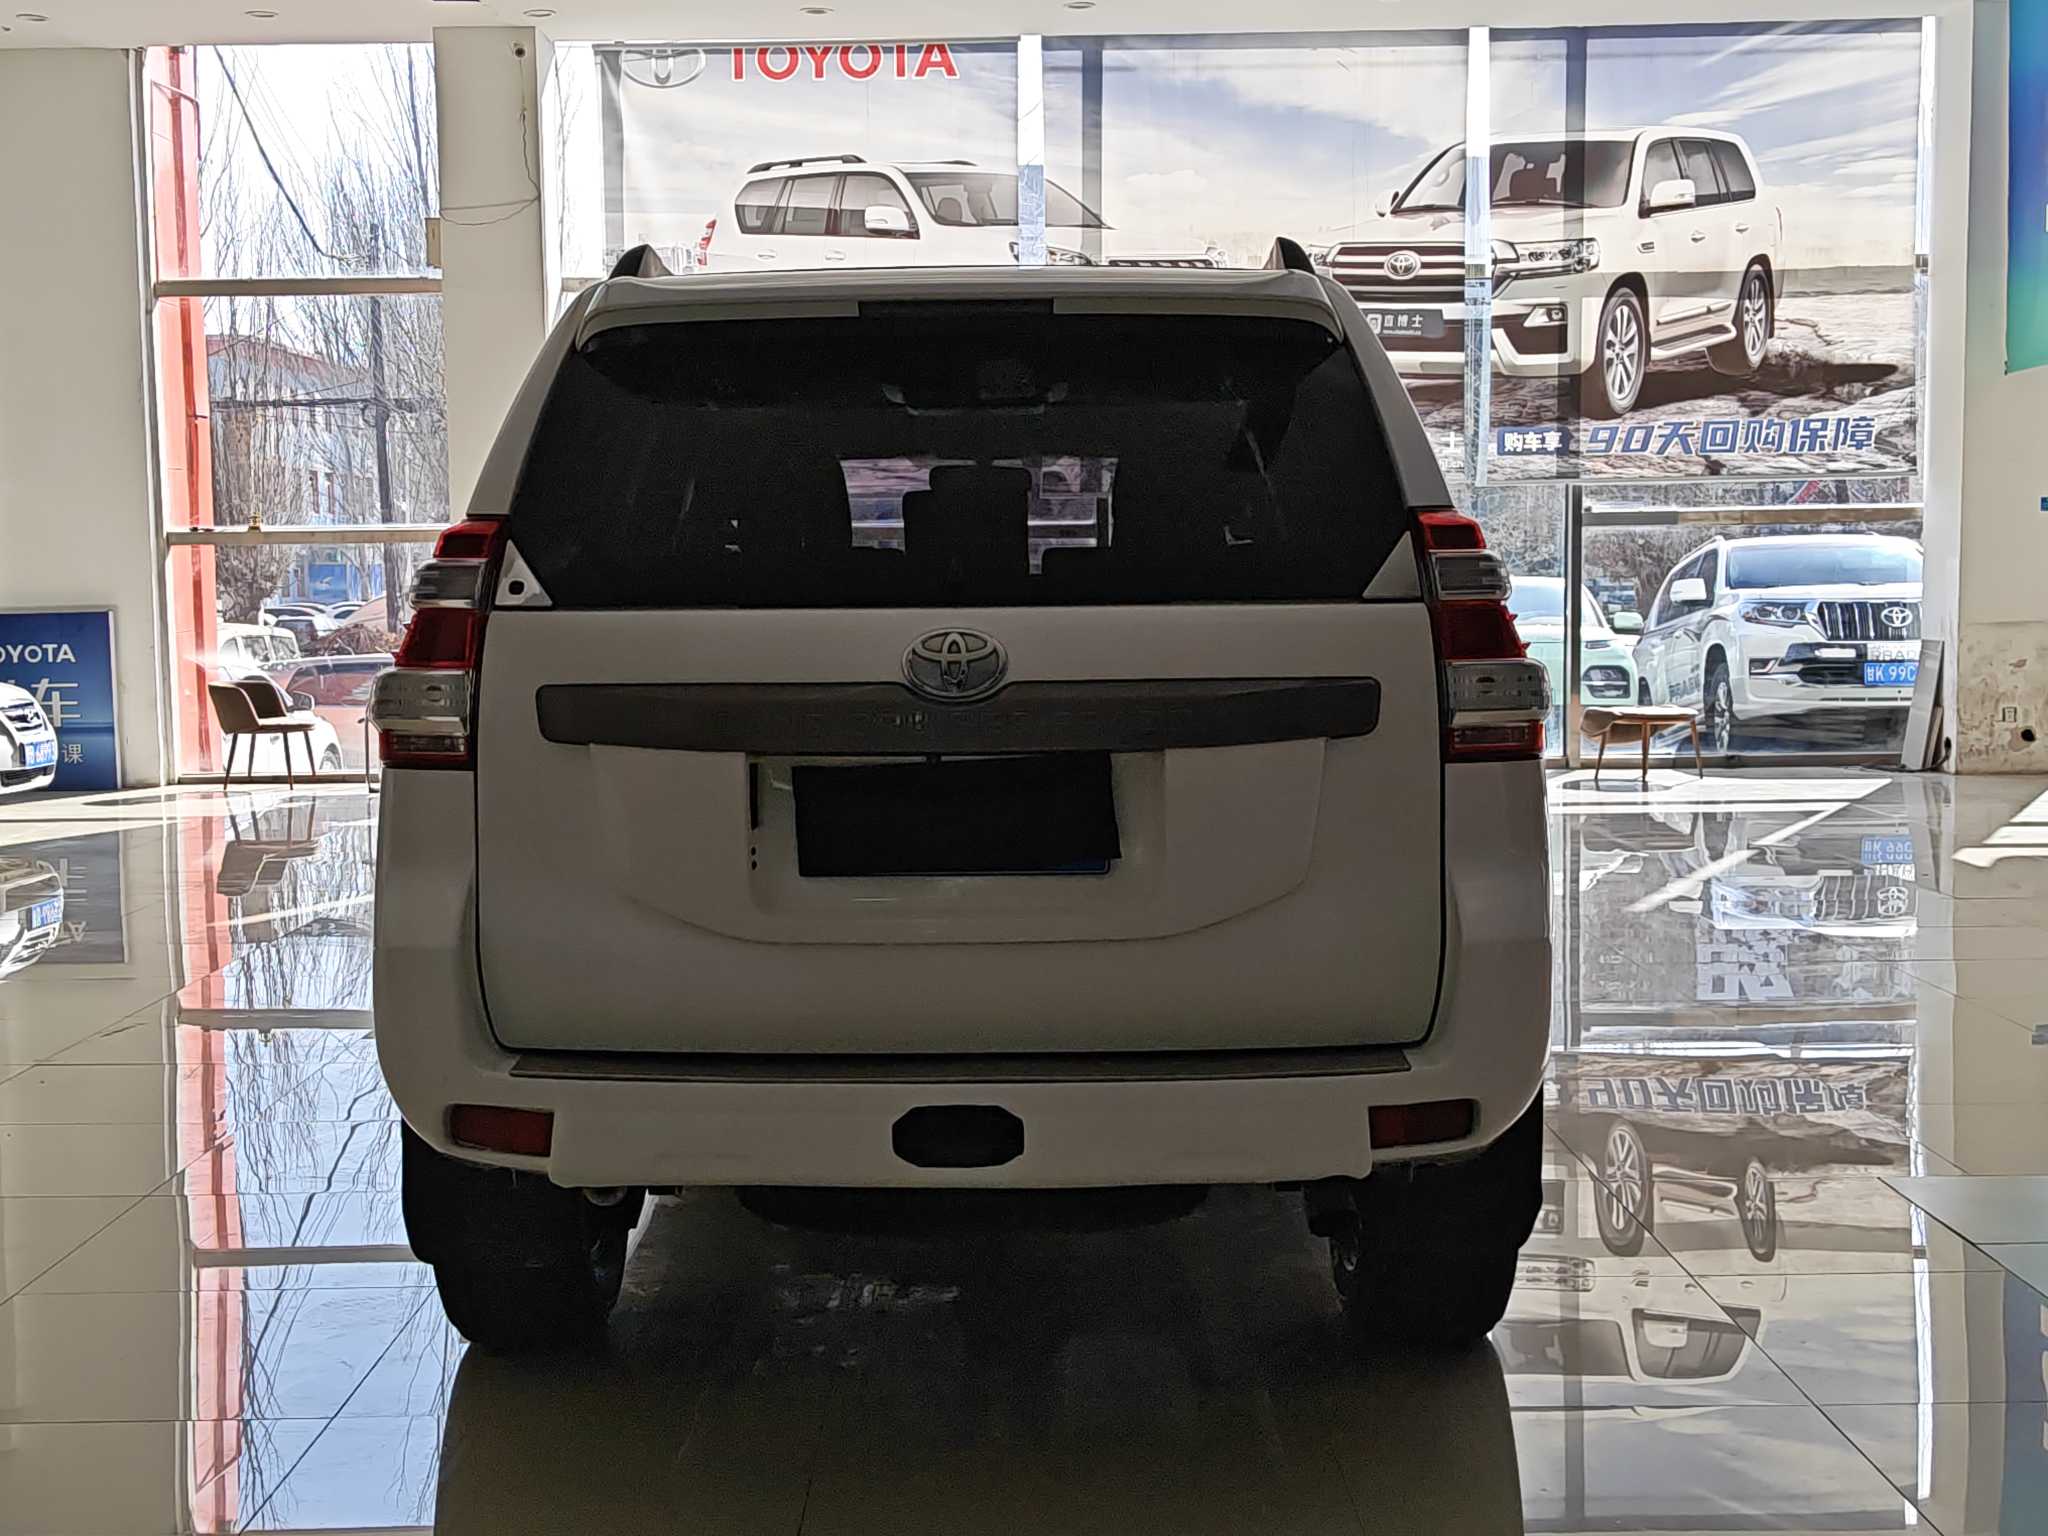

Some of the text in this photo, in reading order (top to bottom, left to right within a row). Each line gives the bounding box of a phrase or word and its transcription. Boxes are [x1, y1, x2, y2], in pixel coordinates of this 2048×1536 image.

[1503, 415, 1877, 454] 购车享 90天回购保障
[62, 743, 84, 764] 课
